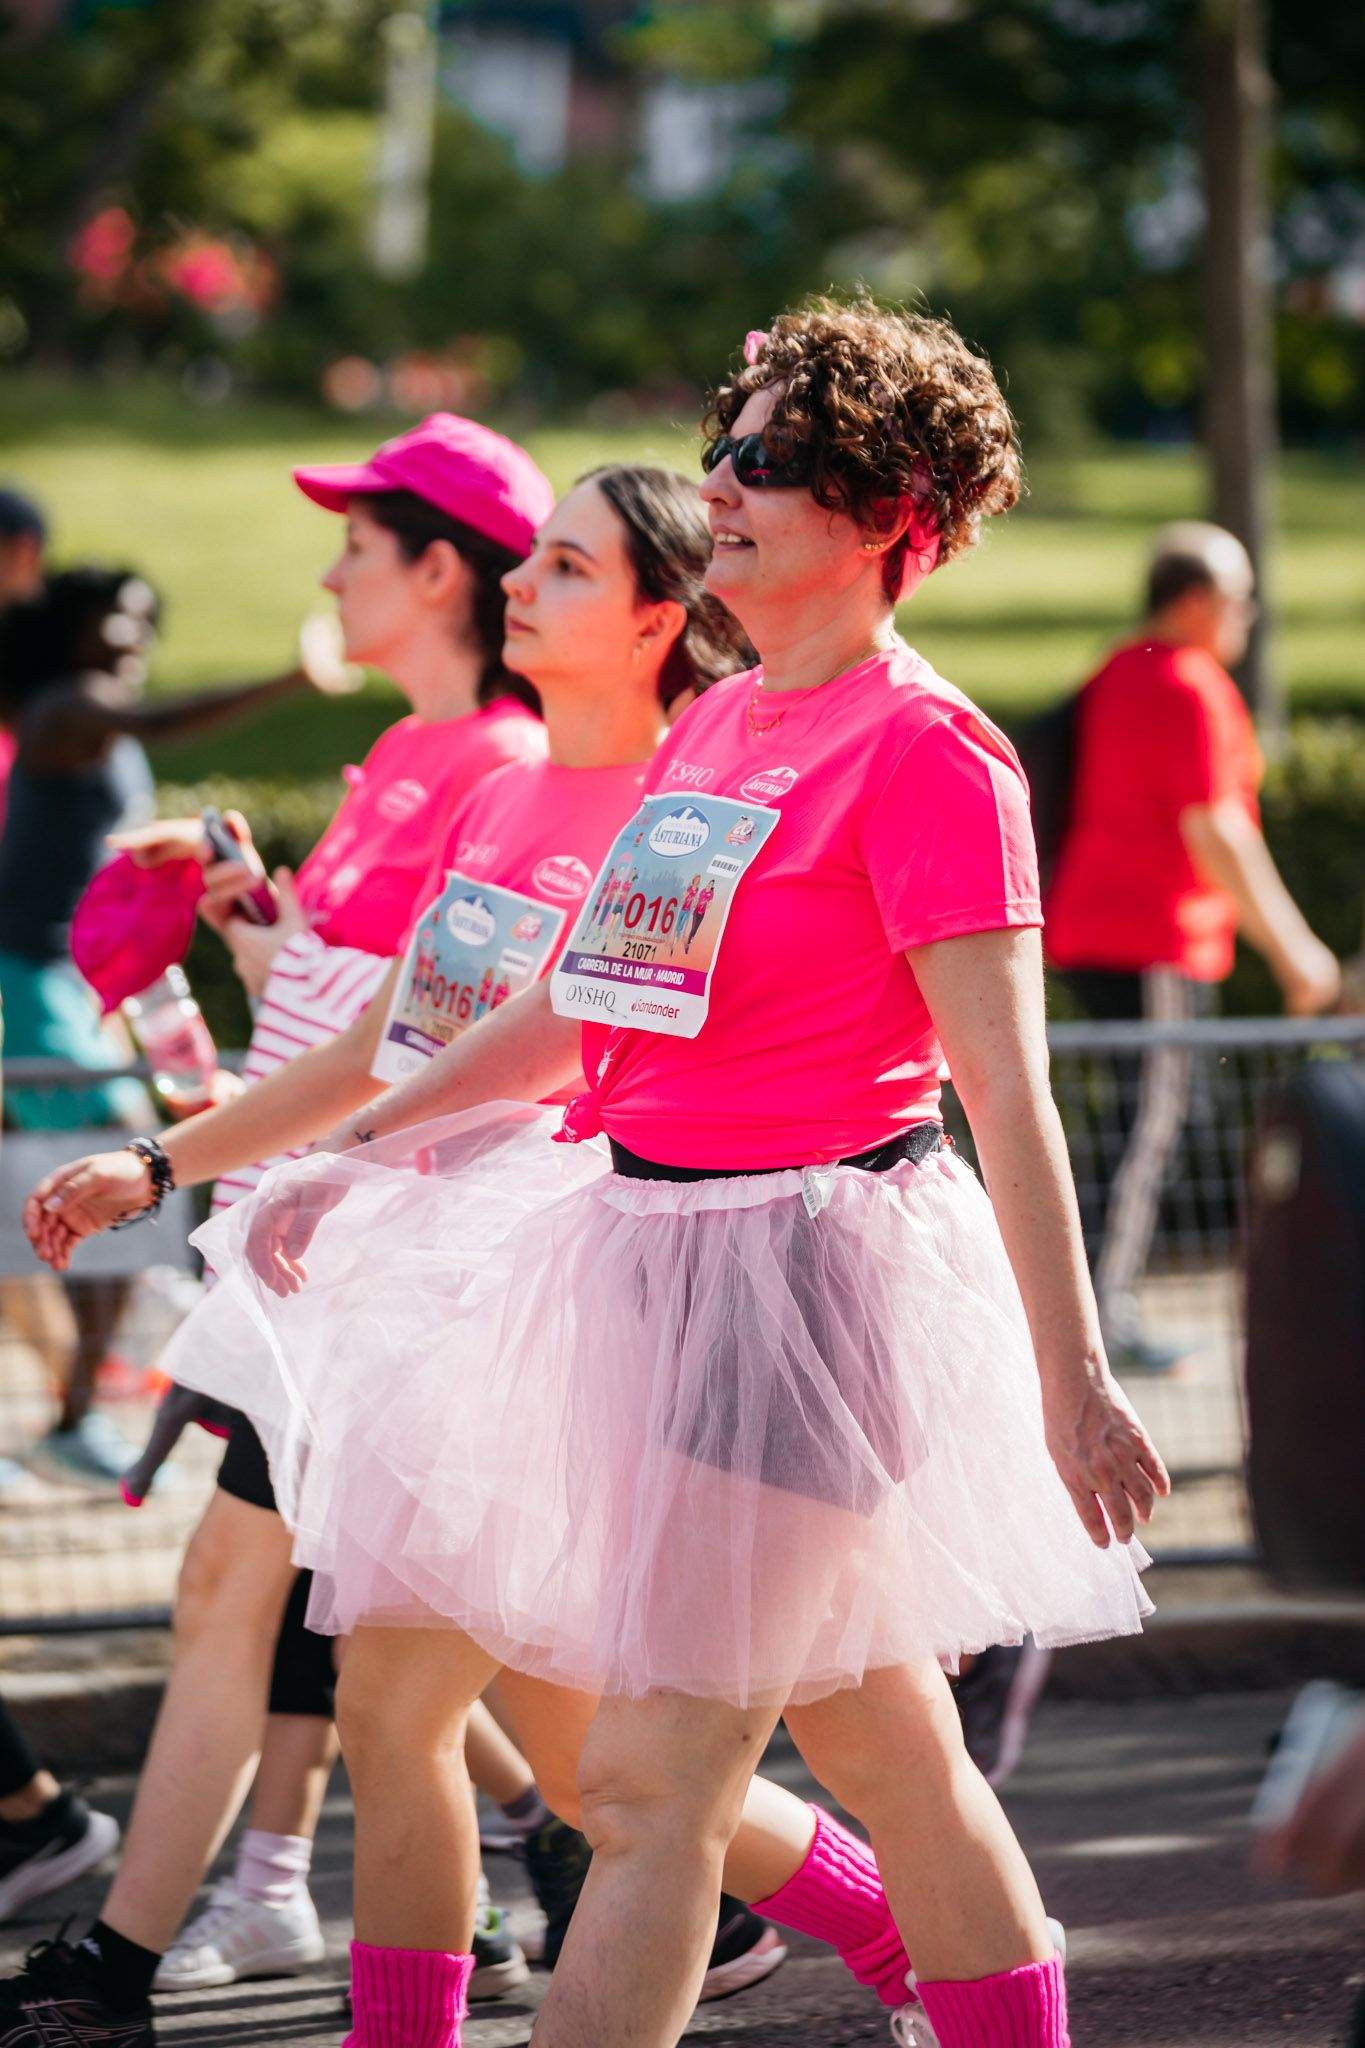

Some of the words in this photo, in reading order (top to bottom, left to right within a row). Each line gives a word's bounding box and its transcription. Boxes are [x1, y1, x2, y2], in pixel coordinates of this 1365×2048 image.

[654, 824, 703, 847] ASTURIANA
[623, 892, 678, 935] 016
[622, 941, 658, 962] 21071
[577, 957, 609, 974] CARRERA
[610, 962, 622, 976] DE
[622, 964, 633, 979] LA
[655, 970, 685, 986] MADRID
[431, 974, 474, 1020] 016
[634, 999, 680, 1019] Santander
